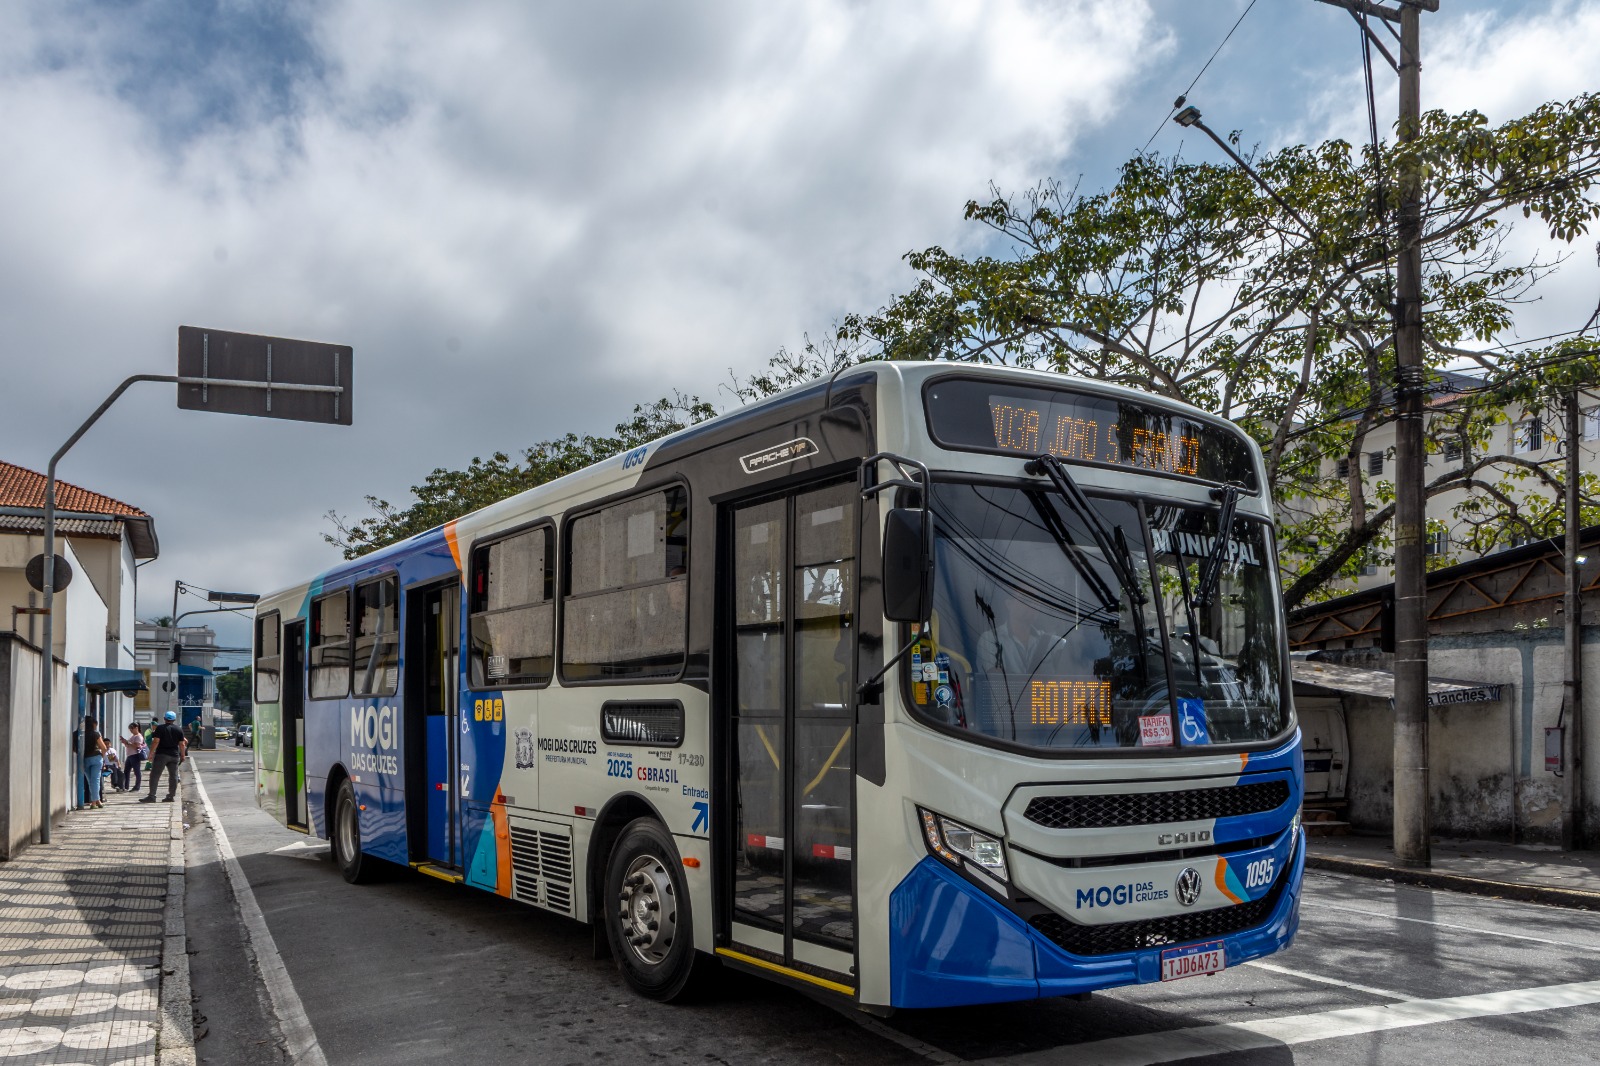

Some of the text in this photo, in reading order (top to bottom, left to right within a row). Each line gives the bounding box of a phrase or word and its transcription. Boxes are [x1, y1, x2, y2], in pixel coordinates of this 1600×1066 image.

[993, 405, 1039, 452] 103A
[621, 447, 648, 470] 1095
[749, 442, 806, 467] APACHE VIP
[351, 705, 398, 750] MOGI
[1142, 717, 1168, 728] TARIFA
[537, 737, 597, 754] MOGI DAS CRUZES
[351, 753, 398, 776] DAS CRUZES
[607, 759, 633, 779] 2025
[677, 753, 705, 767] 17-230
[682, 785, 708, 799] Entrada
[1157, 830, 1211, 846] CAIO
[1245, 857, 1275, 889] 1095
[1076, 883, 1133, 910] MOGI
[1135, 881, 1154, 892] DAS
[1135, 889, 1169, 903] CRUZES
[1168, 951, 1219, 977] TJD6A73
